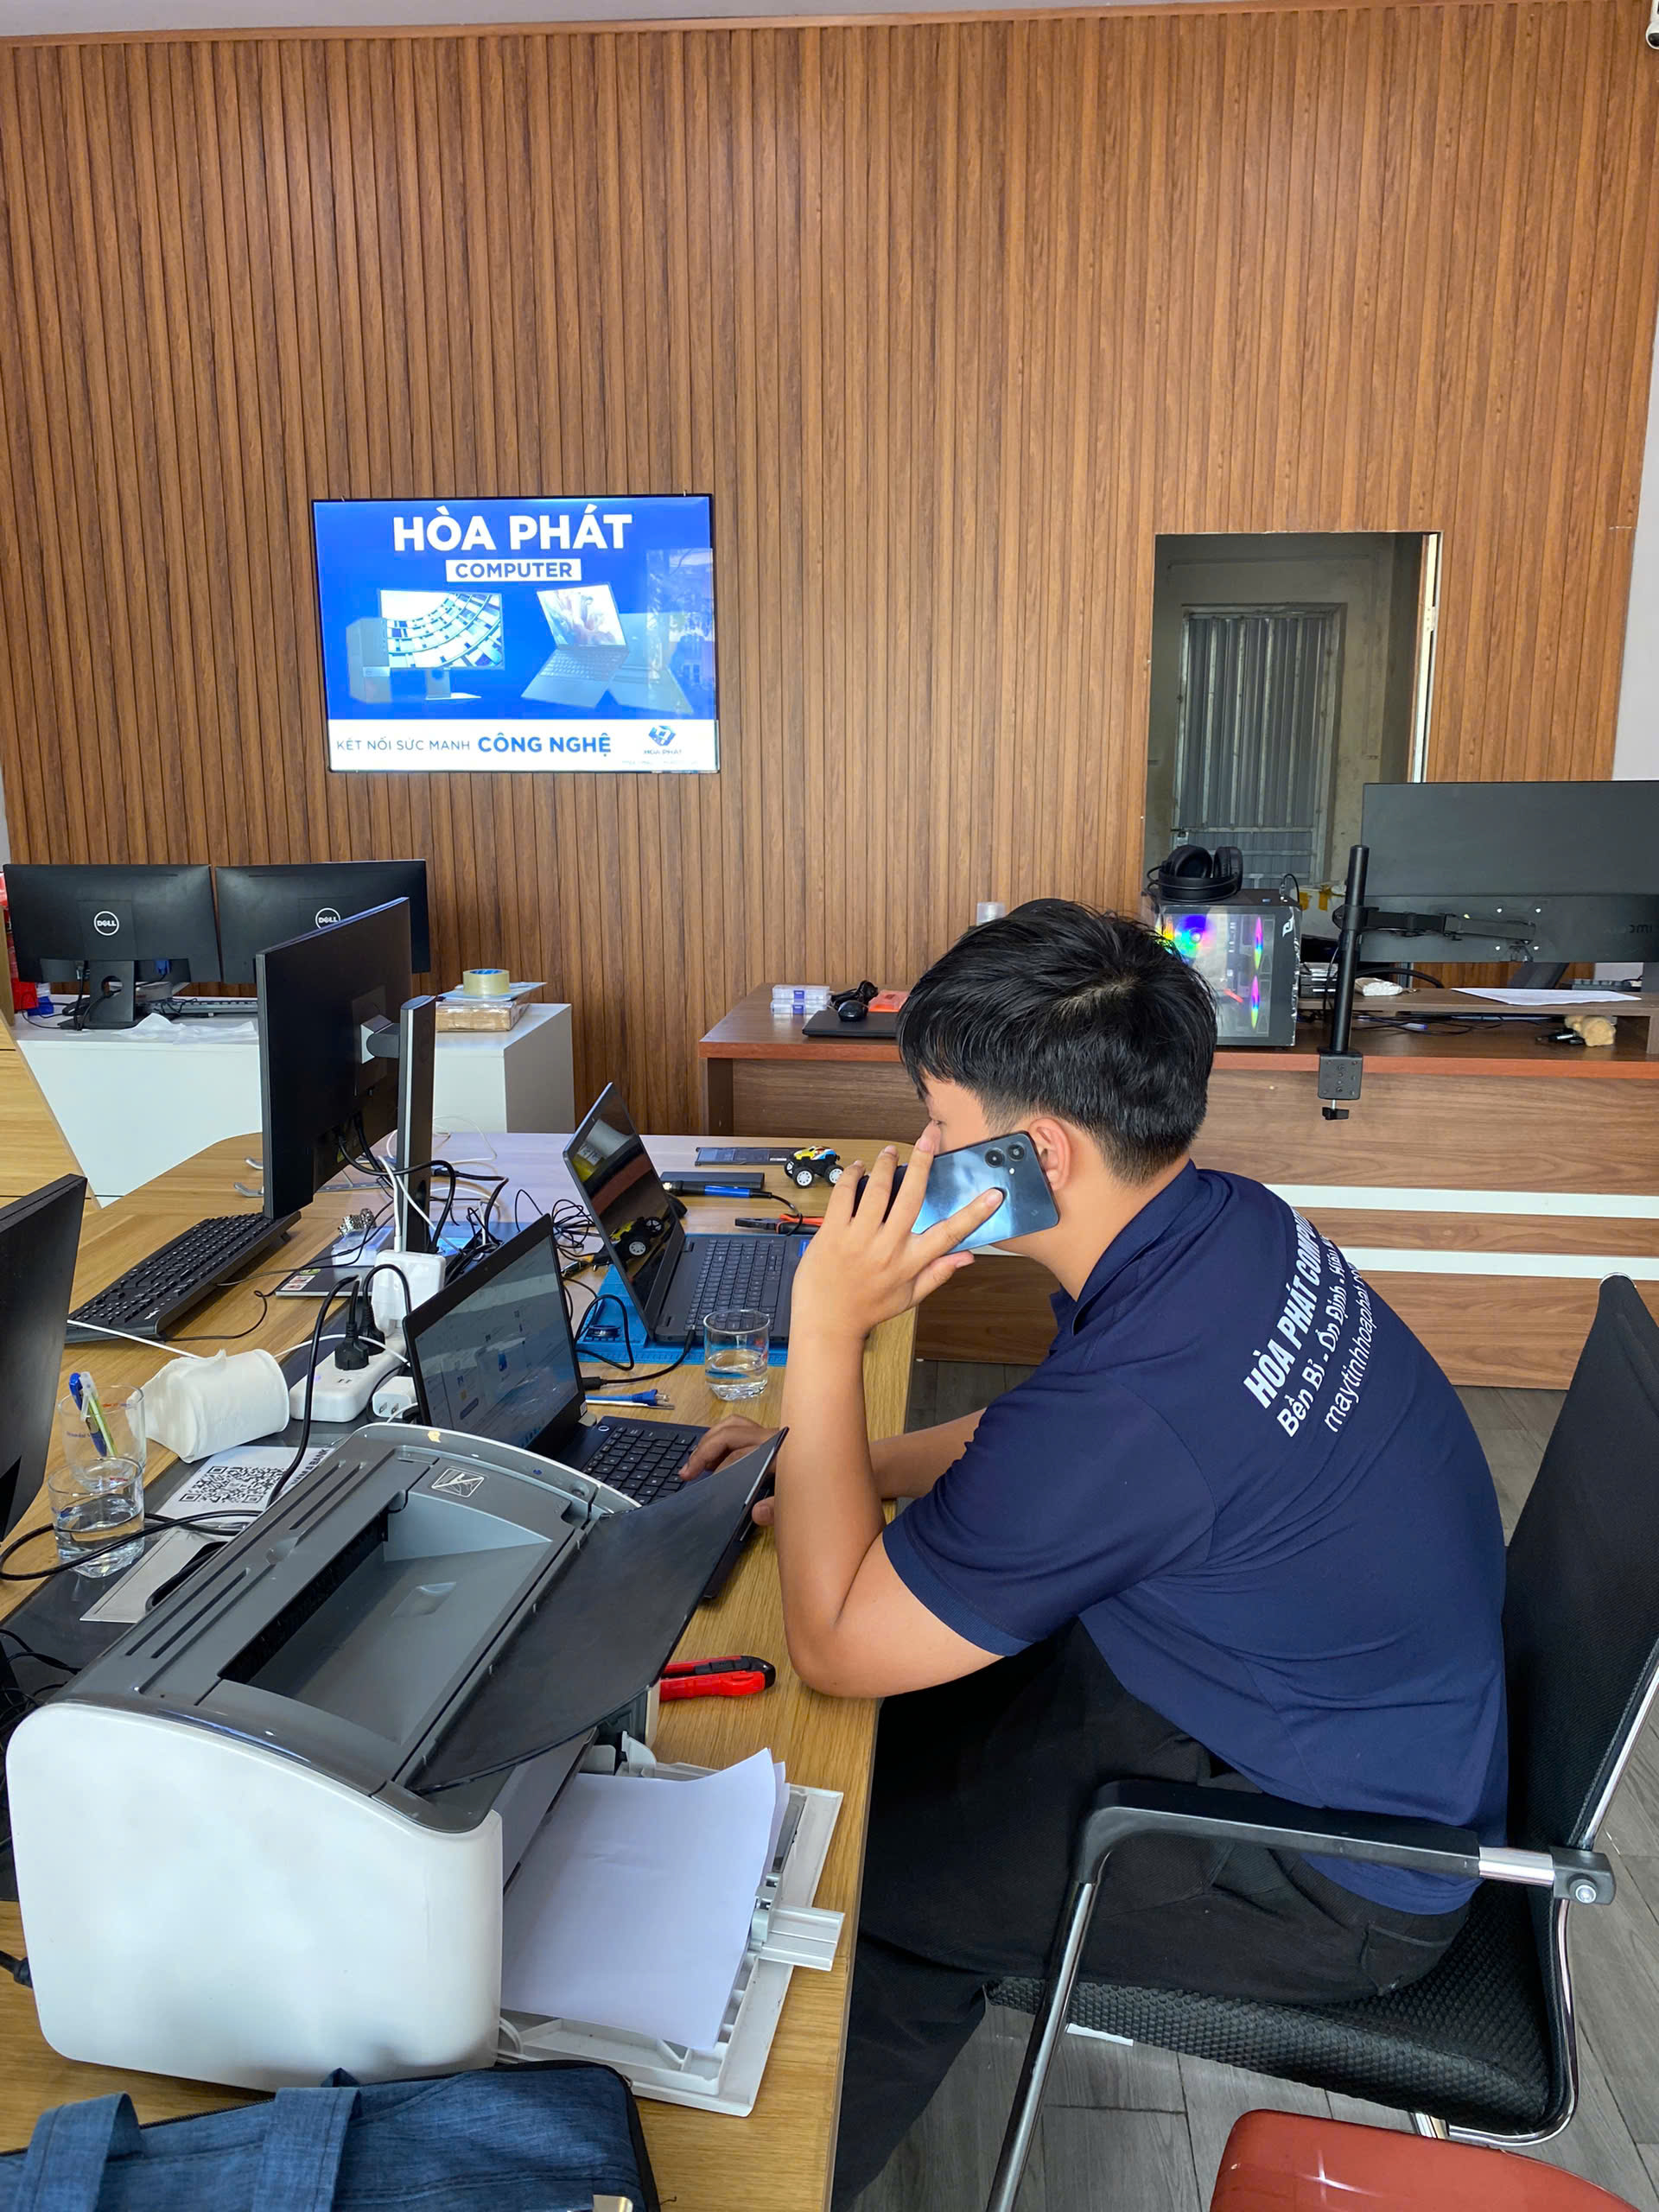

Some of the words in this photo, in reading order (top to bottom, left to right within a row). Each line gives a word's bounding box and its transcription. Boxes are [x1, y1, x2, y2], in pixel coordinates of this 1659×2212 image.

[393, 505, 498, 551] HÒA
[509, 503, 632, 550] PHÁT
[455, 562, 572, 579] COMPUTER
[478, 732, 543, 753] CÔNG
[550, 732, 612, 758] NGHỆ
[1243, 1338, 1295, 1408] HÒA
[1276, 1274, 1318, 1351] PHÁT
[1277, 1394, 1314, 1437] Bền
[1302, 1358, 1325, 1391] Bỉ
[1325, 1285, 1349, 1326] Định
